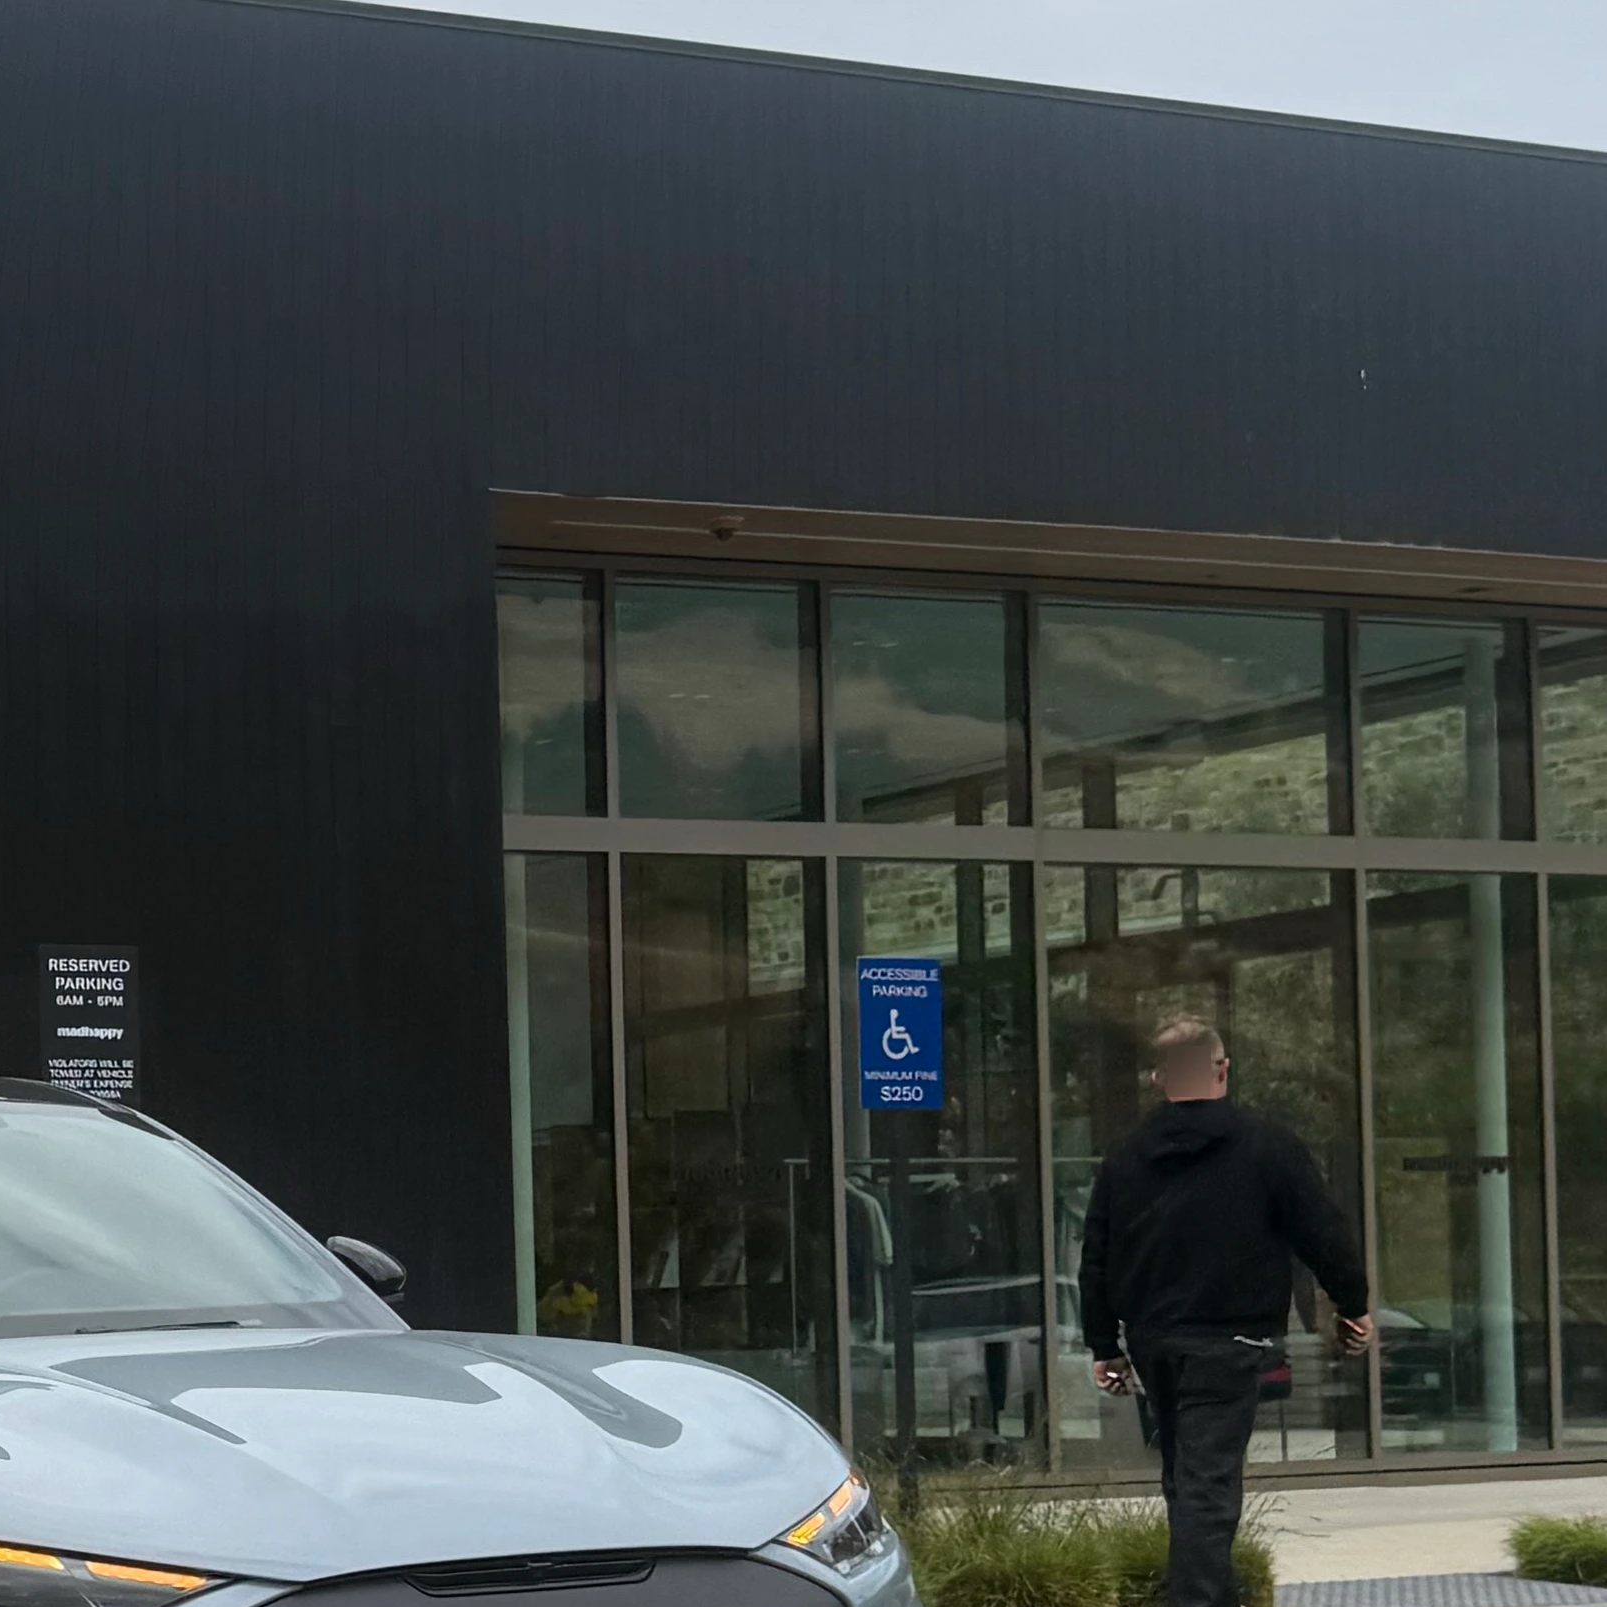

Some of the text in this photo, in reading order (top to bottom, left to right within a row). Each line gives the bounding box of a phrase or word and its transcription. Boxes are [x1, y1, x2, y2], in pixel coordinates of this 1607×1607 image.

[48, 958, 131, 973] RESERVED
[860, 967, 939, 982] ACCESSIBLE
[55, 976, 124, 991] PARKING
[872, 984, 928, 998] PARKING
[55, 994, 84, 1006] 6AM
[56, 1026, 124, 1040] madhappy
[48, 1059, 97, 1069] VIOLATORS
[49, 1069, 82, 1079] TOWED
[83, 1069, 94, 1078] AT
[864, 1070, 938, 1081] MINIMUM FINE
[880, 1085, 924, 1103] $250
